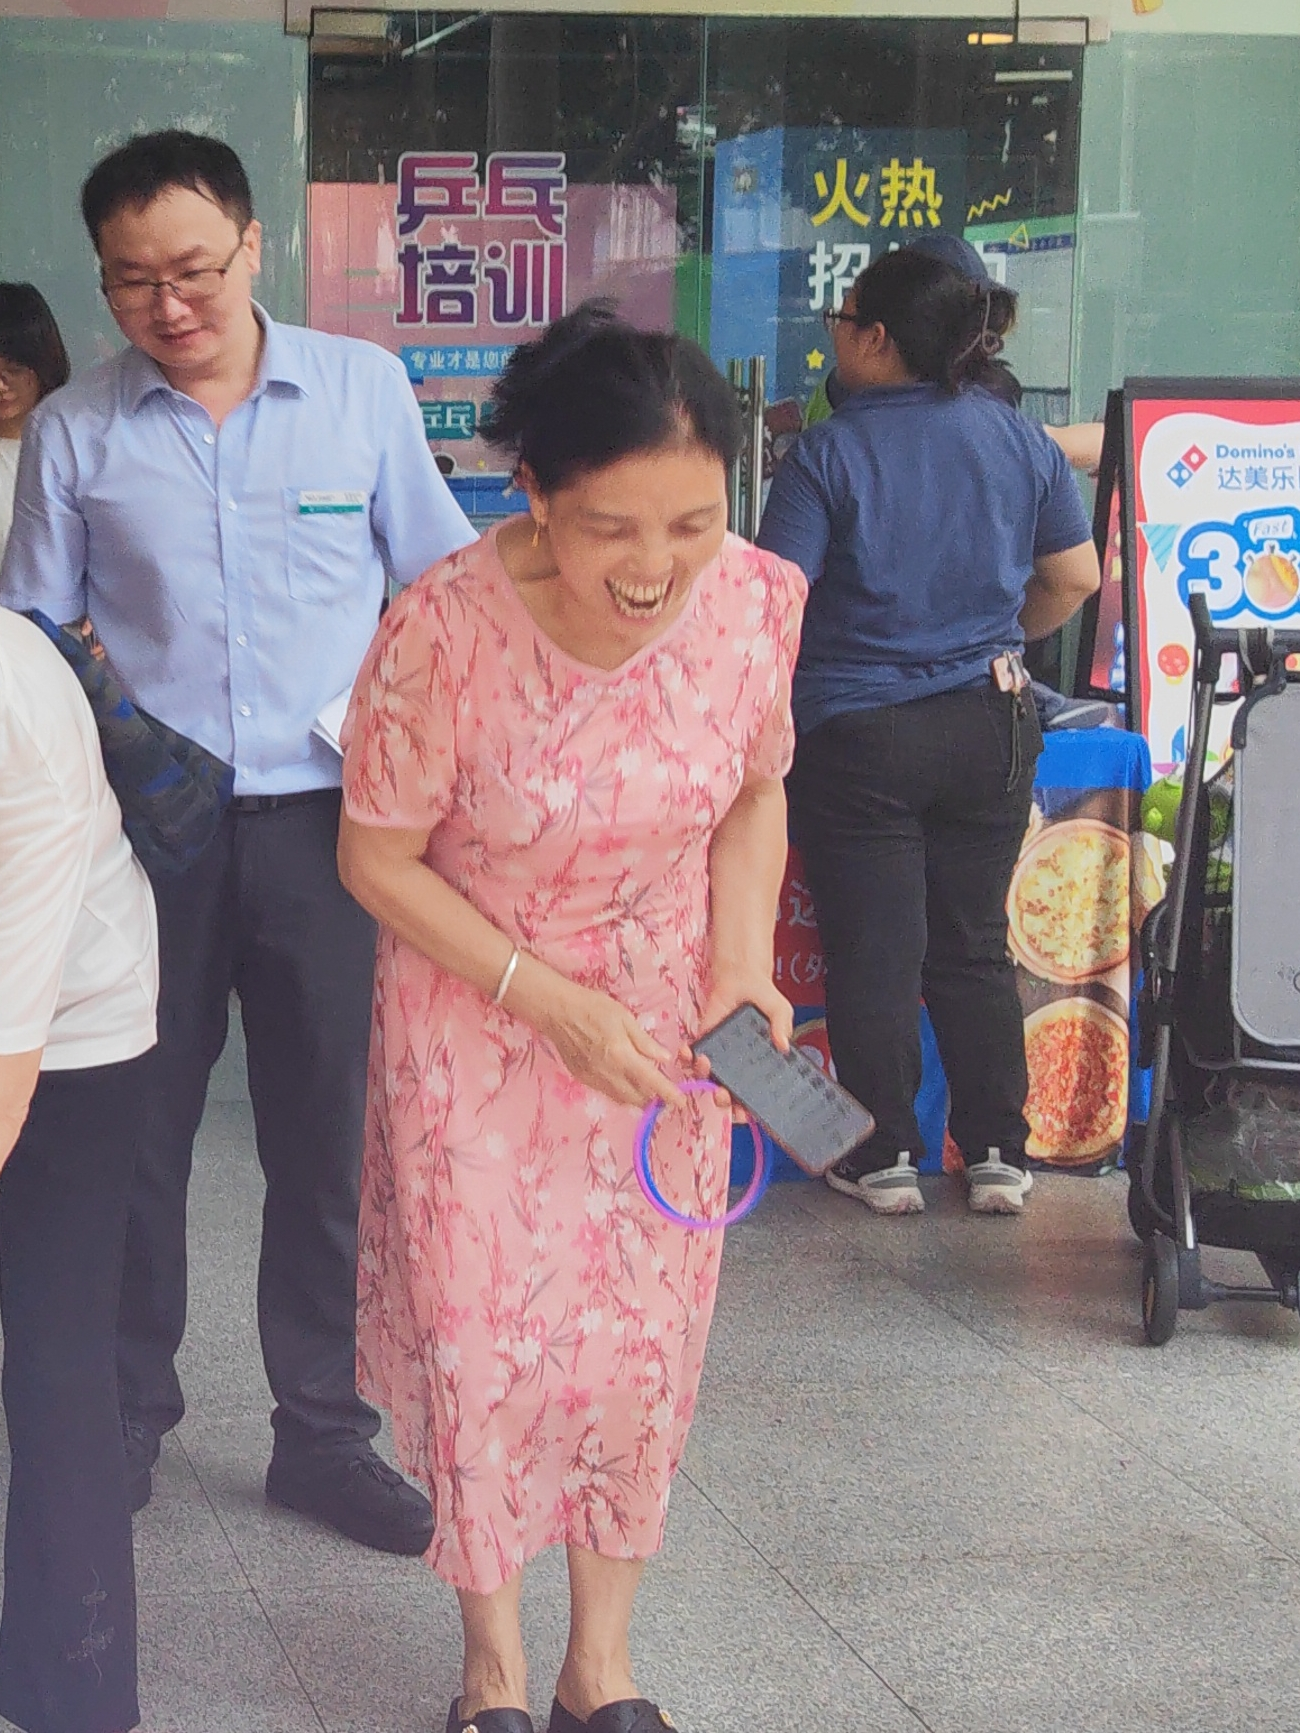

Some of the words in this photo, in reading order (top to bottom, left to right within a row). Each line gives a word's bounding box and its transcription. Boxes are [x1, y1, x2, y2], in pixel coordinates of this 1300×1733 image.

[395, 151, 567, 238] 乒乓
[810, 157, 943, 228] 火热
[394, 239, 567, 326] 培训
[1215, 443, 1296, 459] Domino's
[1217, 465, 1300, 492] 达美乐
[1252, 518, 1288, 538] Fast
